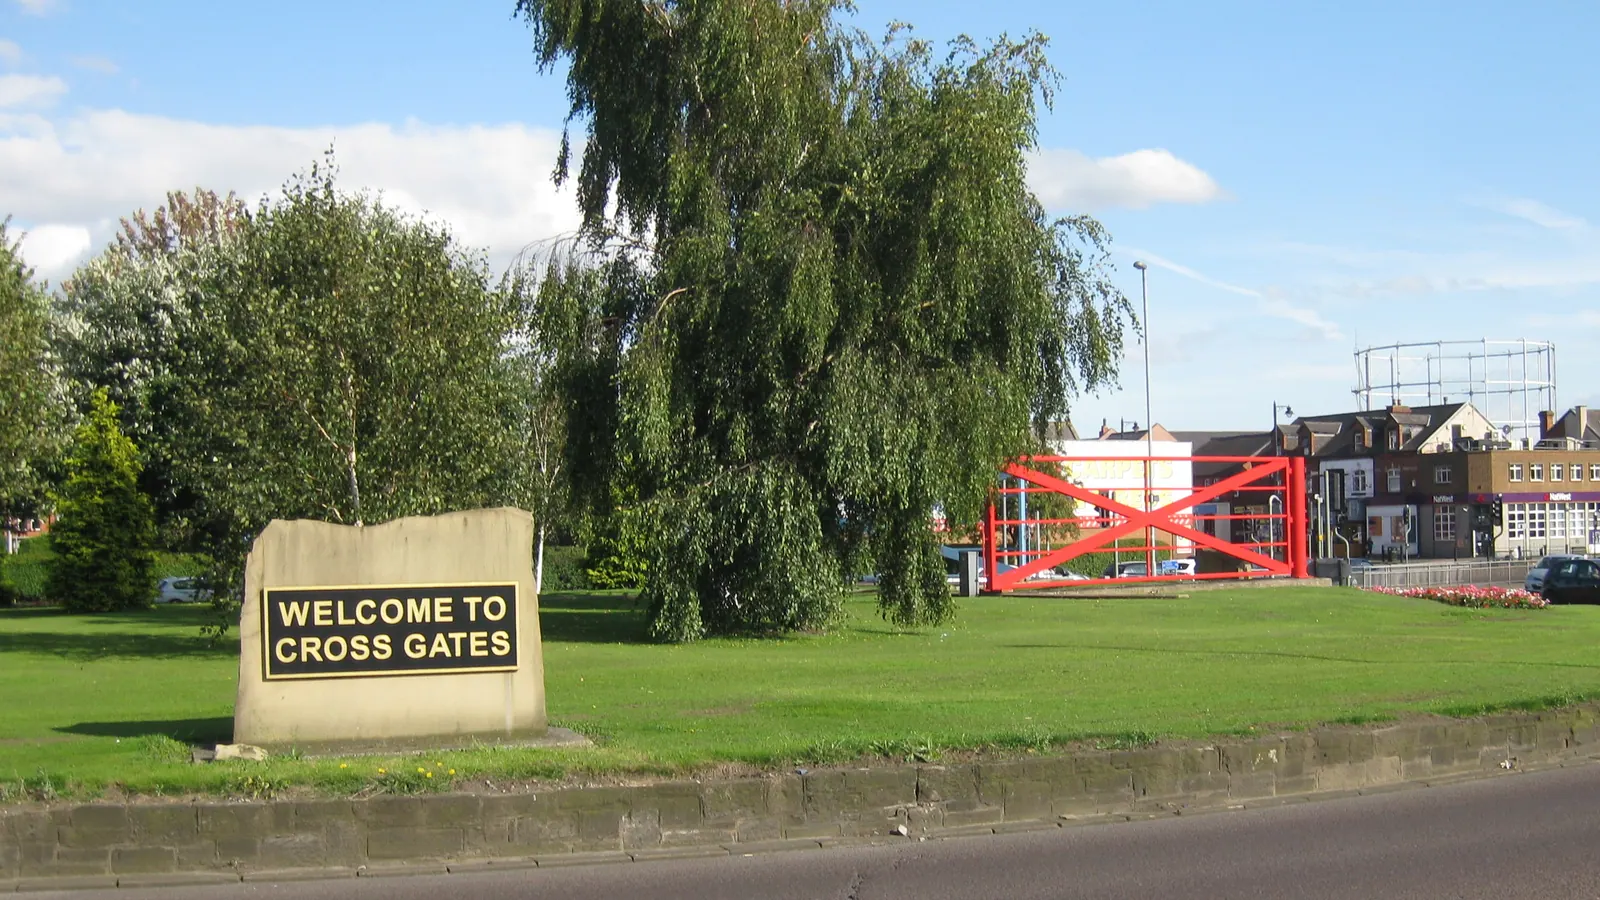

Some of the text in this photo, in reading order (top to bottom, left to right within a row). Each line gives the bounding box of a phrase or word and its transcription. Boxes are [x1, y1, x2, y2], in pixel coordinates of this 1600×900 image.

[1433, 495, 1454, 503] NatWest
[1549, 492, 1572, 501] NatWest
[278, 595, 507, 627] WELCOME TO
[275, 630, 511, 663] CROSS GATES
